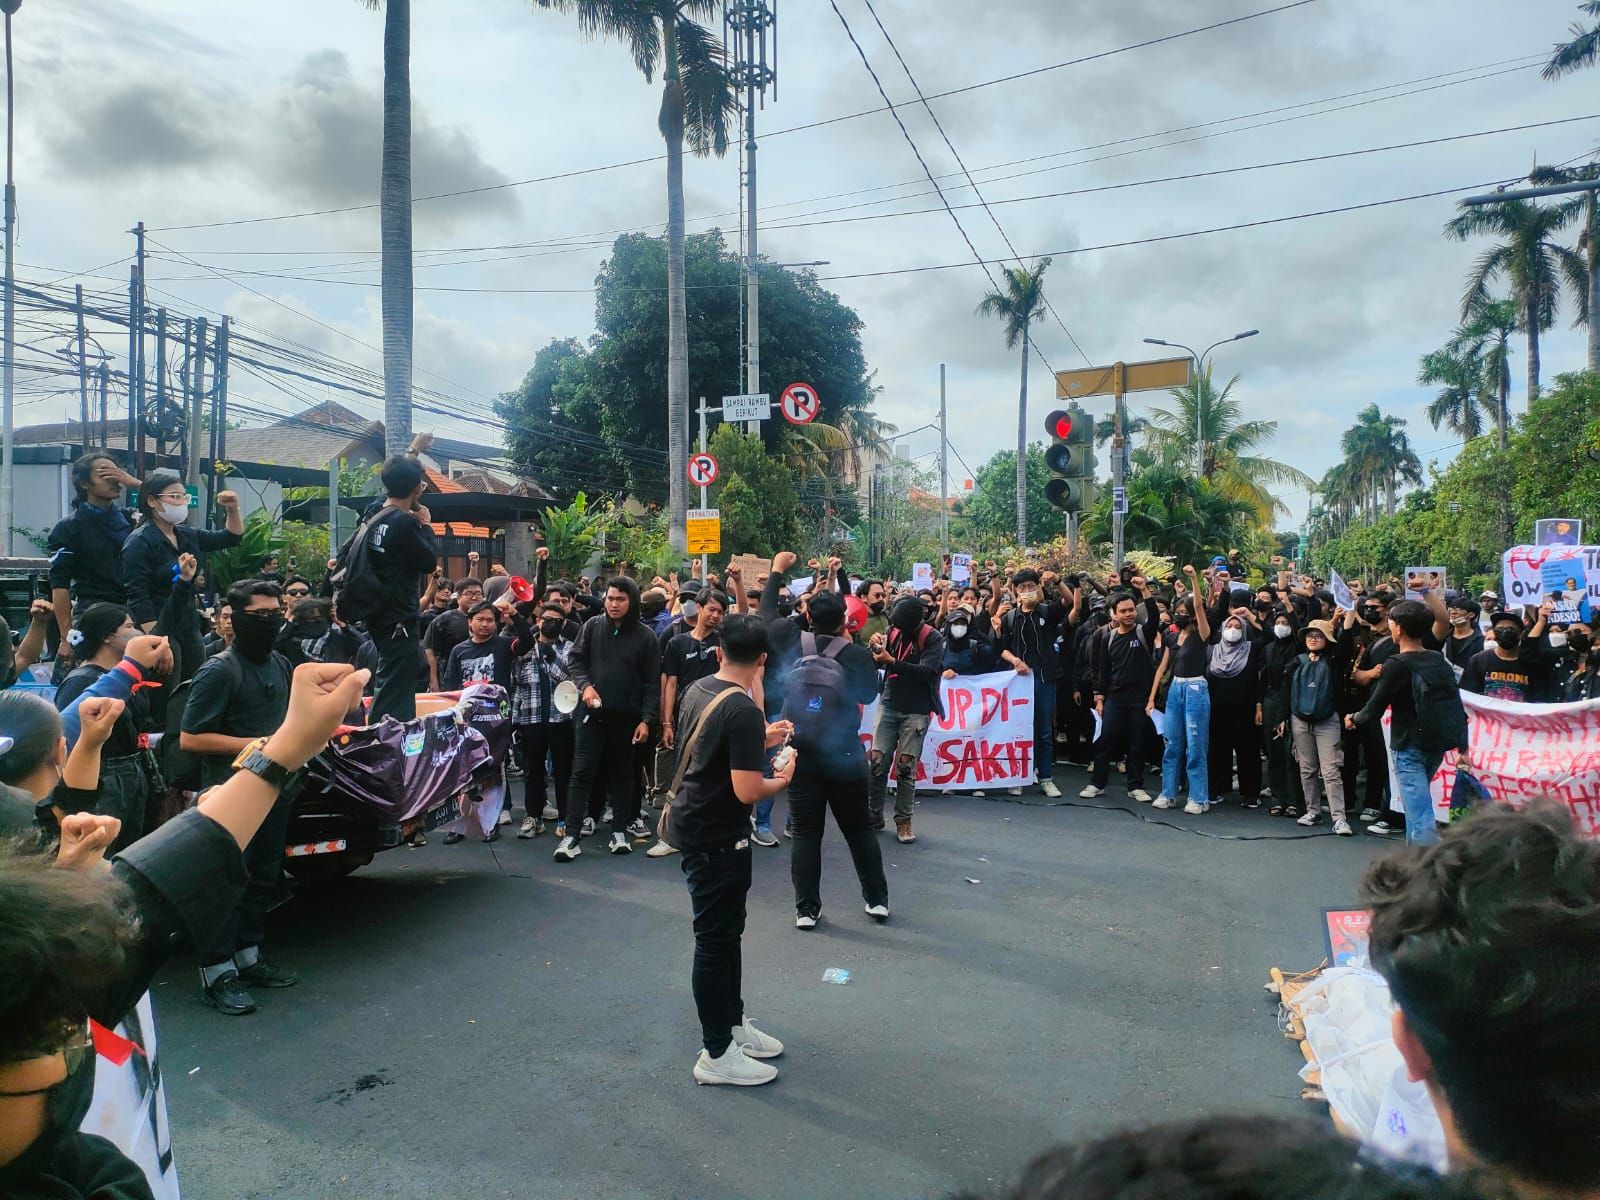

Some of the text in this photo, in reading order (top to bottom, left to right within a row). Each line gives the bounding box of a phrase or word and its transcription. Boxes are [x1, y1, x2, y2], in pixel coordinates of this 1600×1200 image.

[725, 397, 767, 409] SAMPAI RAMBU
[687, 510, 719, 519] PERHATIAN
[930, 687, 973, 731] UP
[933, 739, 1033, 785] SAKIT
